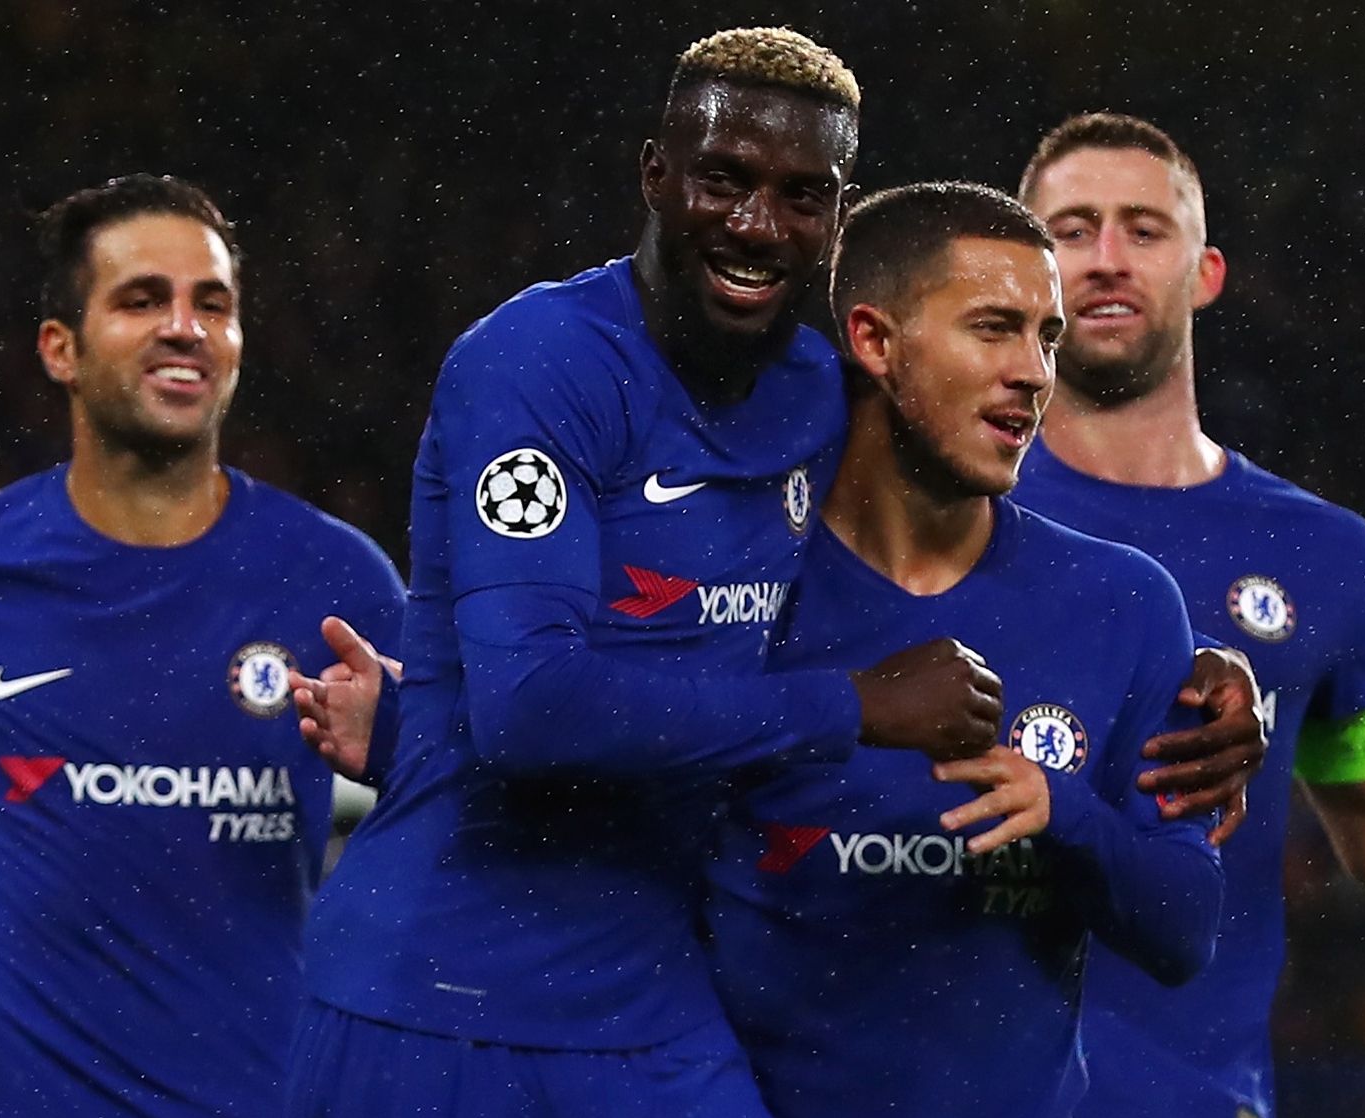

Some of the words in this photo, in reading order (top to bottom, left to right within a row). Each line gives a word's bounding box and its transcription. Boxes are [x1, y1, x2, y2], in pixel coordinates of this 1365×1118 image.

[1022, 706, 1072, 725] CHELSEA
[63, 762, 295, 808] YOKOHAMA
[208, 812, 295, 843] TYRES
